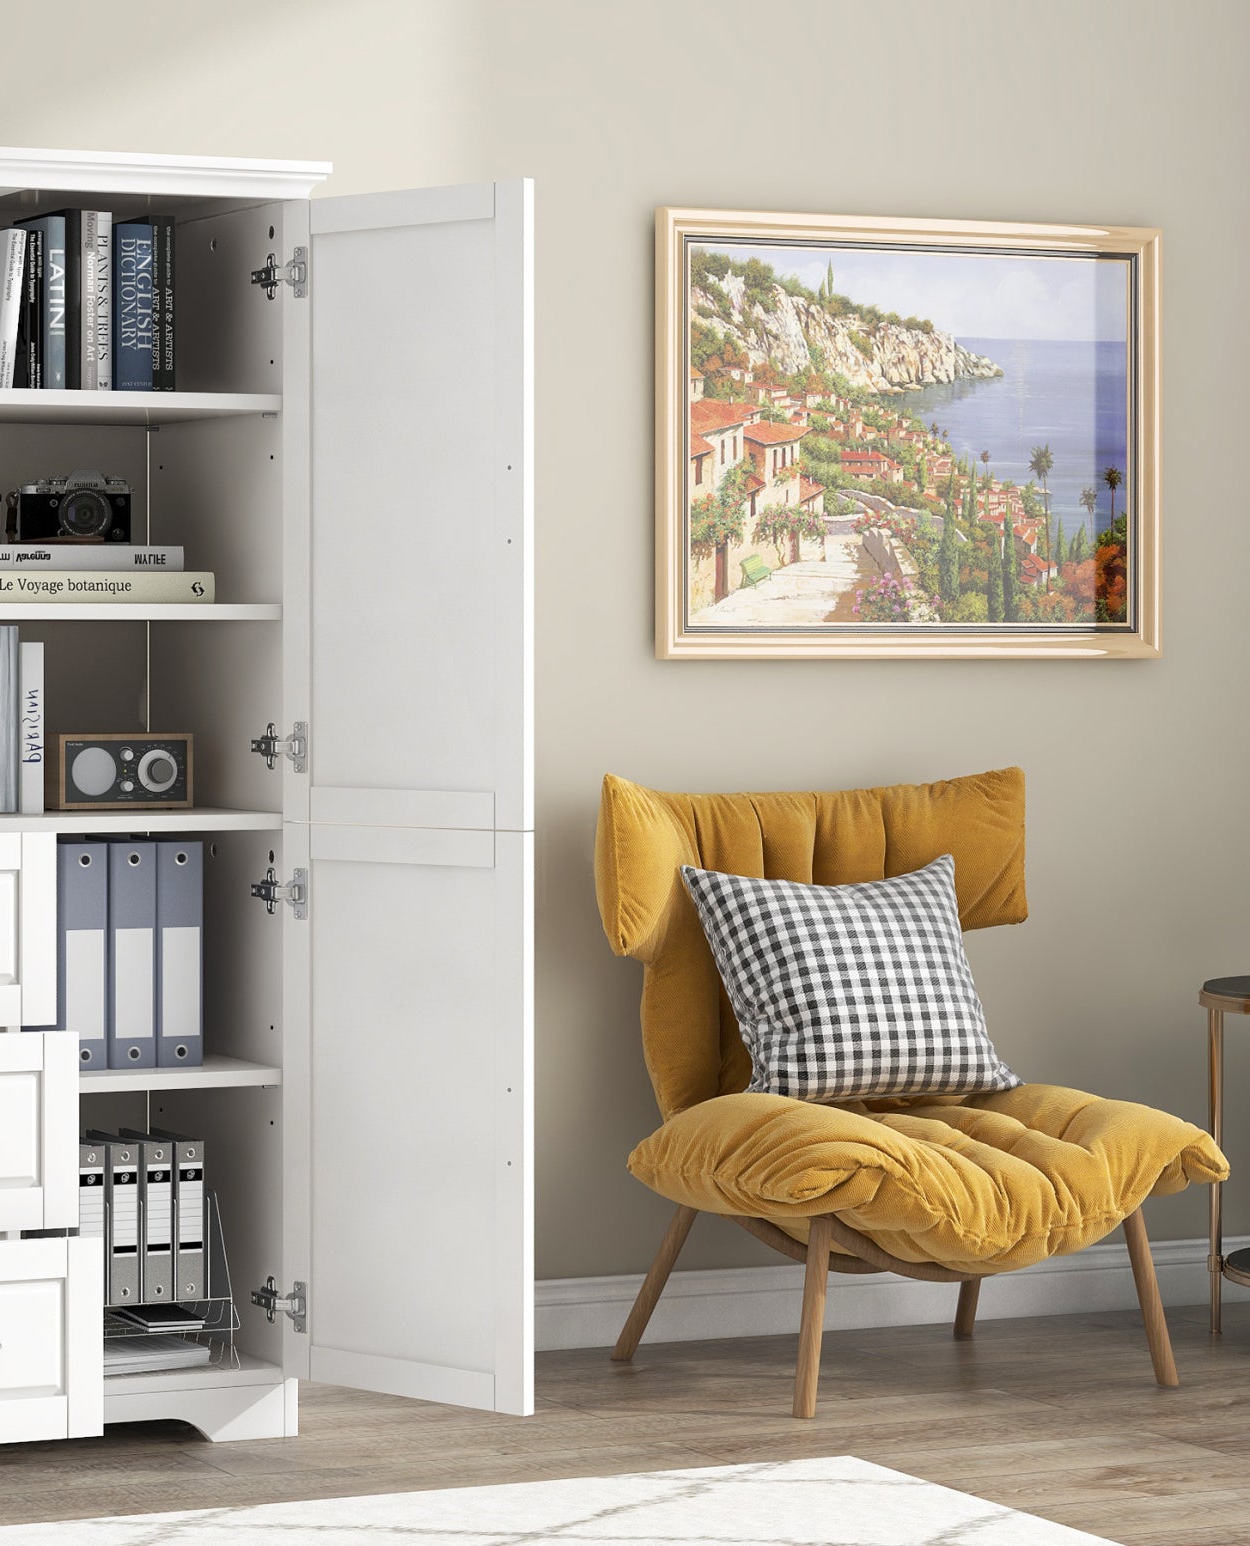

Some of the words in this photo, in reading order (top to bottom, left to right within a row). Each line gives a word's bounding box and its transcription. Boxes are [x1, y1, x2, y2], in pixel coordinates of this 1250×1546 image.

[84, 213, 94, 248] Moving
[86, 252, 95, 292] Norman
[97, 235, 108, 293] PLANTS
[49, 249, 64, 329] LATIN
[97, 295, 108, 309] &
[121, 238, 137, 351] DICTIONARY
[136, 239, 152, 350] ENGLISH
[152, 287, 160, 310] ART
[165, 287, 173, 311] ART
[86, 295, 95, 328] Foster
[86, 331, 93, 343] on
[86, 345, 95, 361] Art
[97, 312, 108, 361] TREES
[152, 323, 160, 370] ARTISTS
[165, 324, 173, 370] ARTISTS
[17, 578, 63, 594] Voyage
[67, 578, 132, 594] botanique
